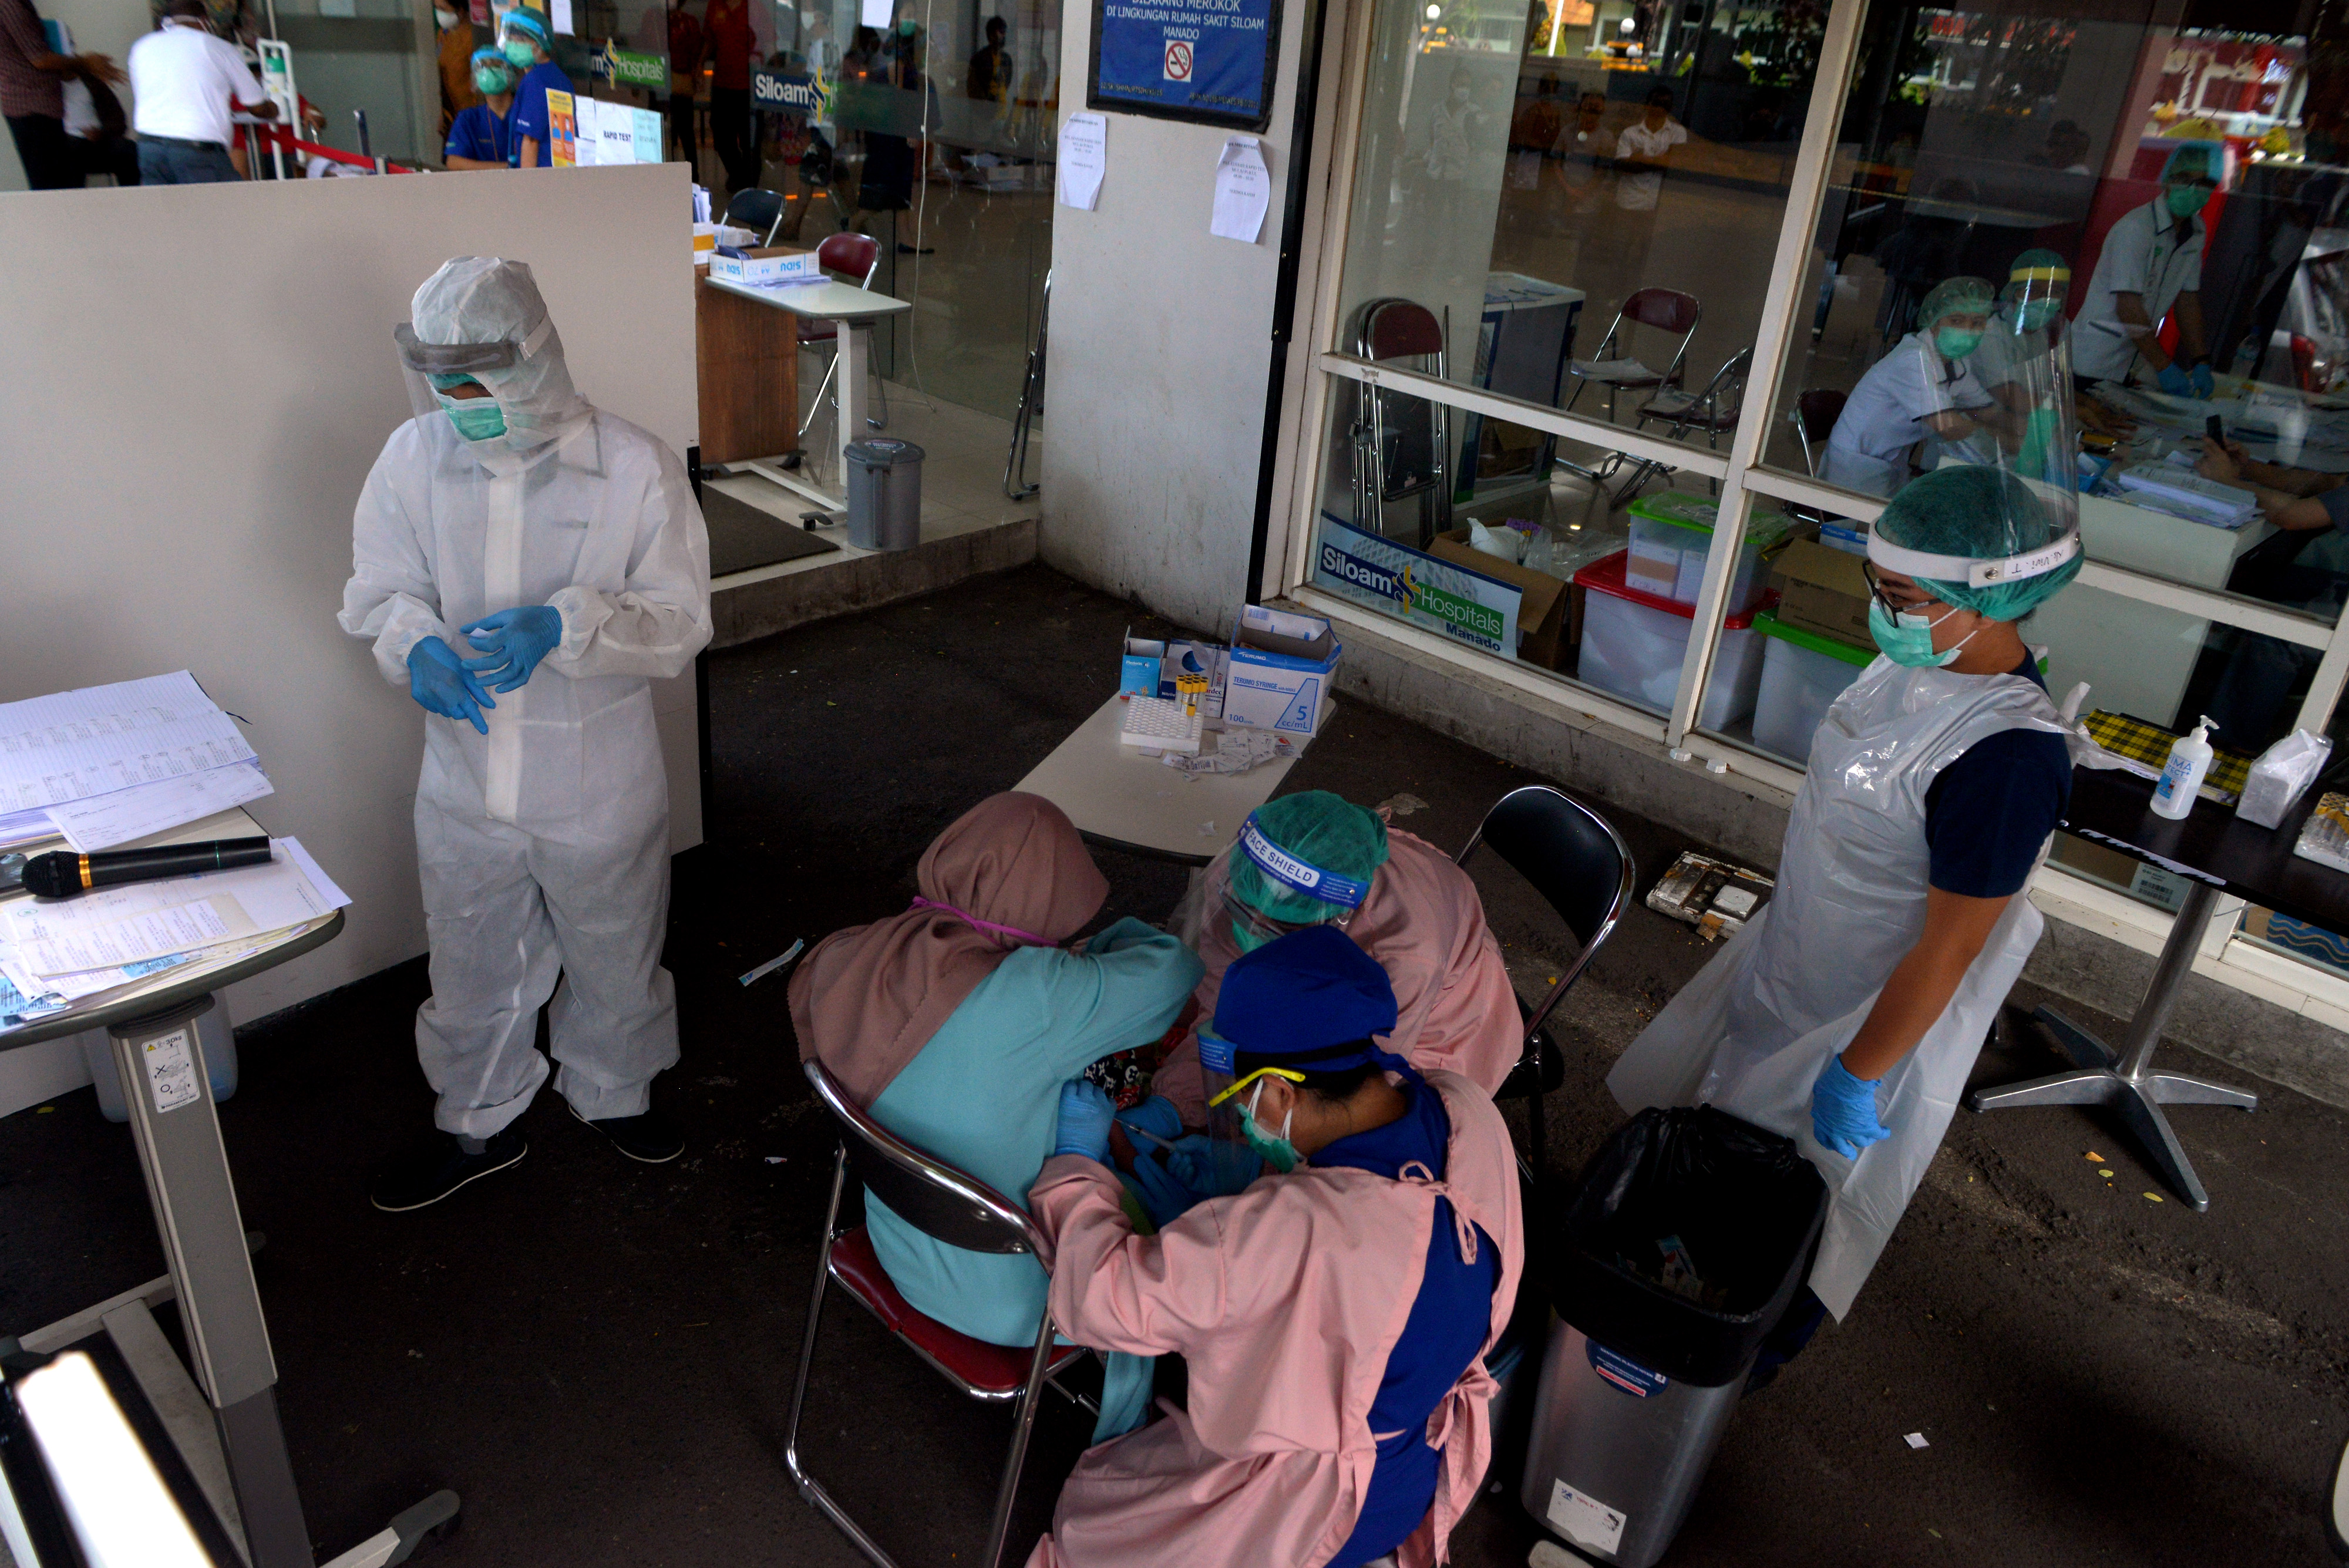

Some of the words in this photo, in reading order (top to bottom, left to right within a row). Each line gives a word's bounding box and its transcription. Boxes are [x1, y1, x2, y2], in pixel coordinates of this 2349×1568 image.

[1107, 5, 1116, 16] DI
[1118, 7, 1169, 22] LINGKUNGAN
[1171, 12, 1201, 24] RUMAH
[1204, 14, 1229, 26] SAKIT
[1231, 16, 1264, 29] SILOAM
[1163, 26, 1199, 39] MANADO
[618, 55, 664, 82] Hospitals
[755, 73, 809, 105] Siloam
[603, 130, 617, 140] RAPID
[618, 133, 631, 142] TEST
[1323, 547, 1392, 594] Siloam
[1422, 587, 1501, 635] Hospitals
[1446, 622, 1501, 652] Manado
[1234, 677, 1255, 686] TERUMO
[1256, 681, 1278, 690] SYRINGE
[1230, 714, 1244, 723] 100
[1282, 721, 1308, 729] cc/mL
[1296, 706, 1307, 721] 5
[1248, 833, 1266, 856] FACE
[1268, 852, 1313, 881] SHIELD
